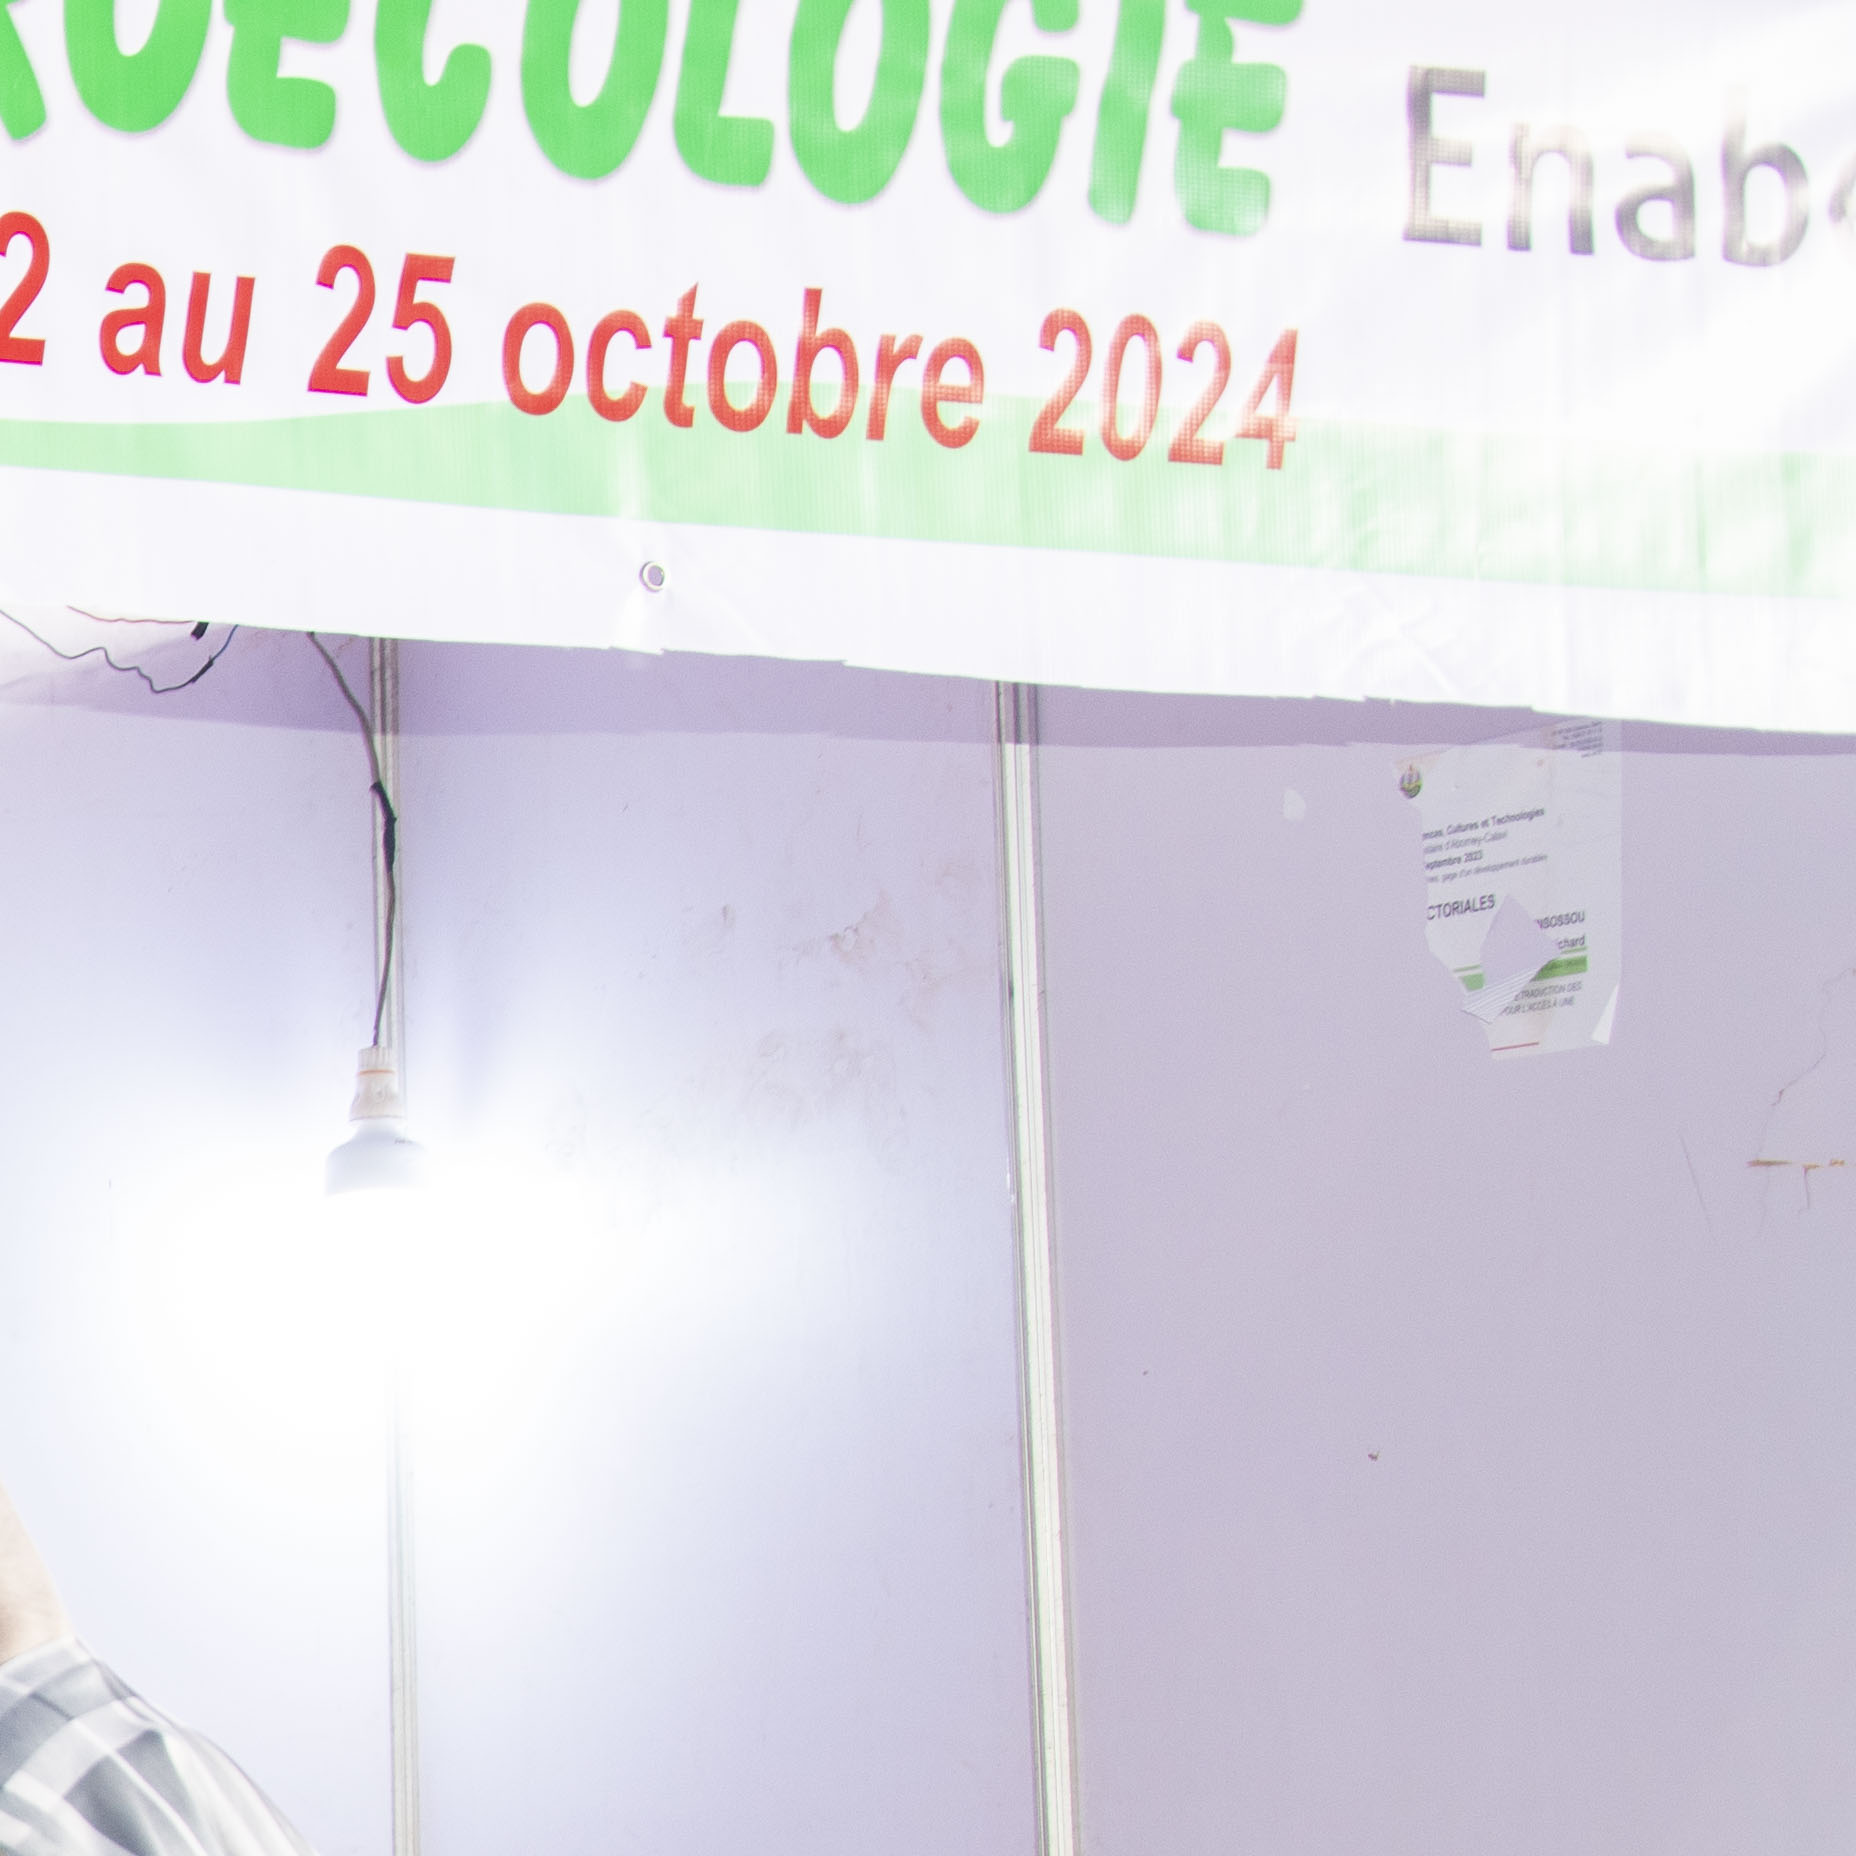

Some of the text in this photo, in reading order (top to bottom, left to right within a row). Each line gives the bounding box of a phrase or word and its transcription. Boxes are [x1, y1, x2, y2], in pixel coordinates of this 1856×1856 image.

[99, 262, 255, 385] au
[307, 245, 456, 404] 25
[503, 282, 985, 449] octobre
[1028, 308, 1299, 470] 2024
